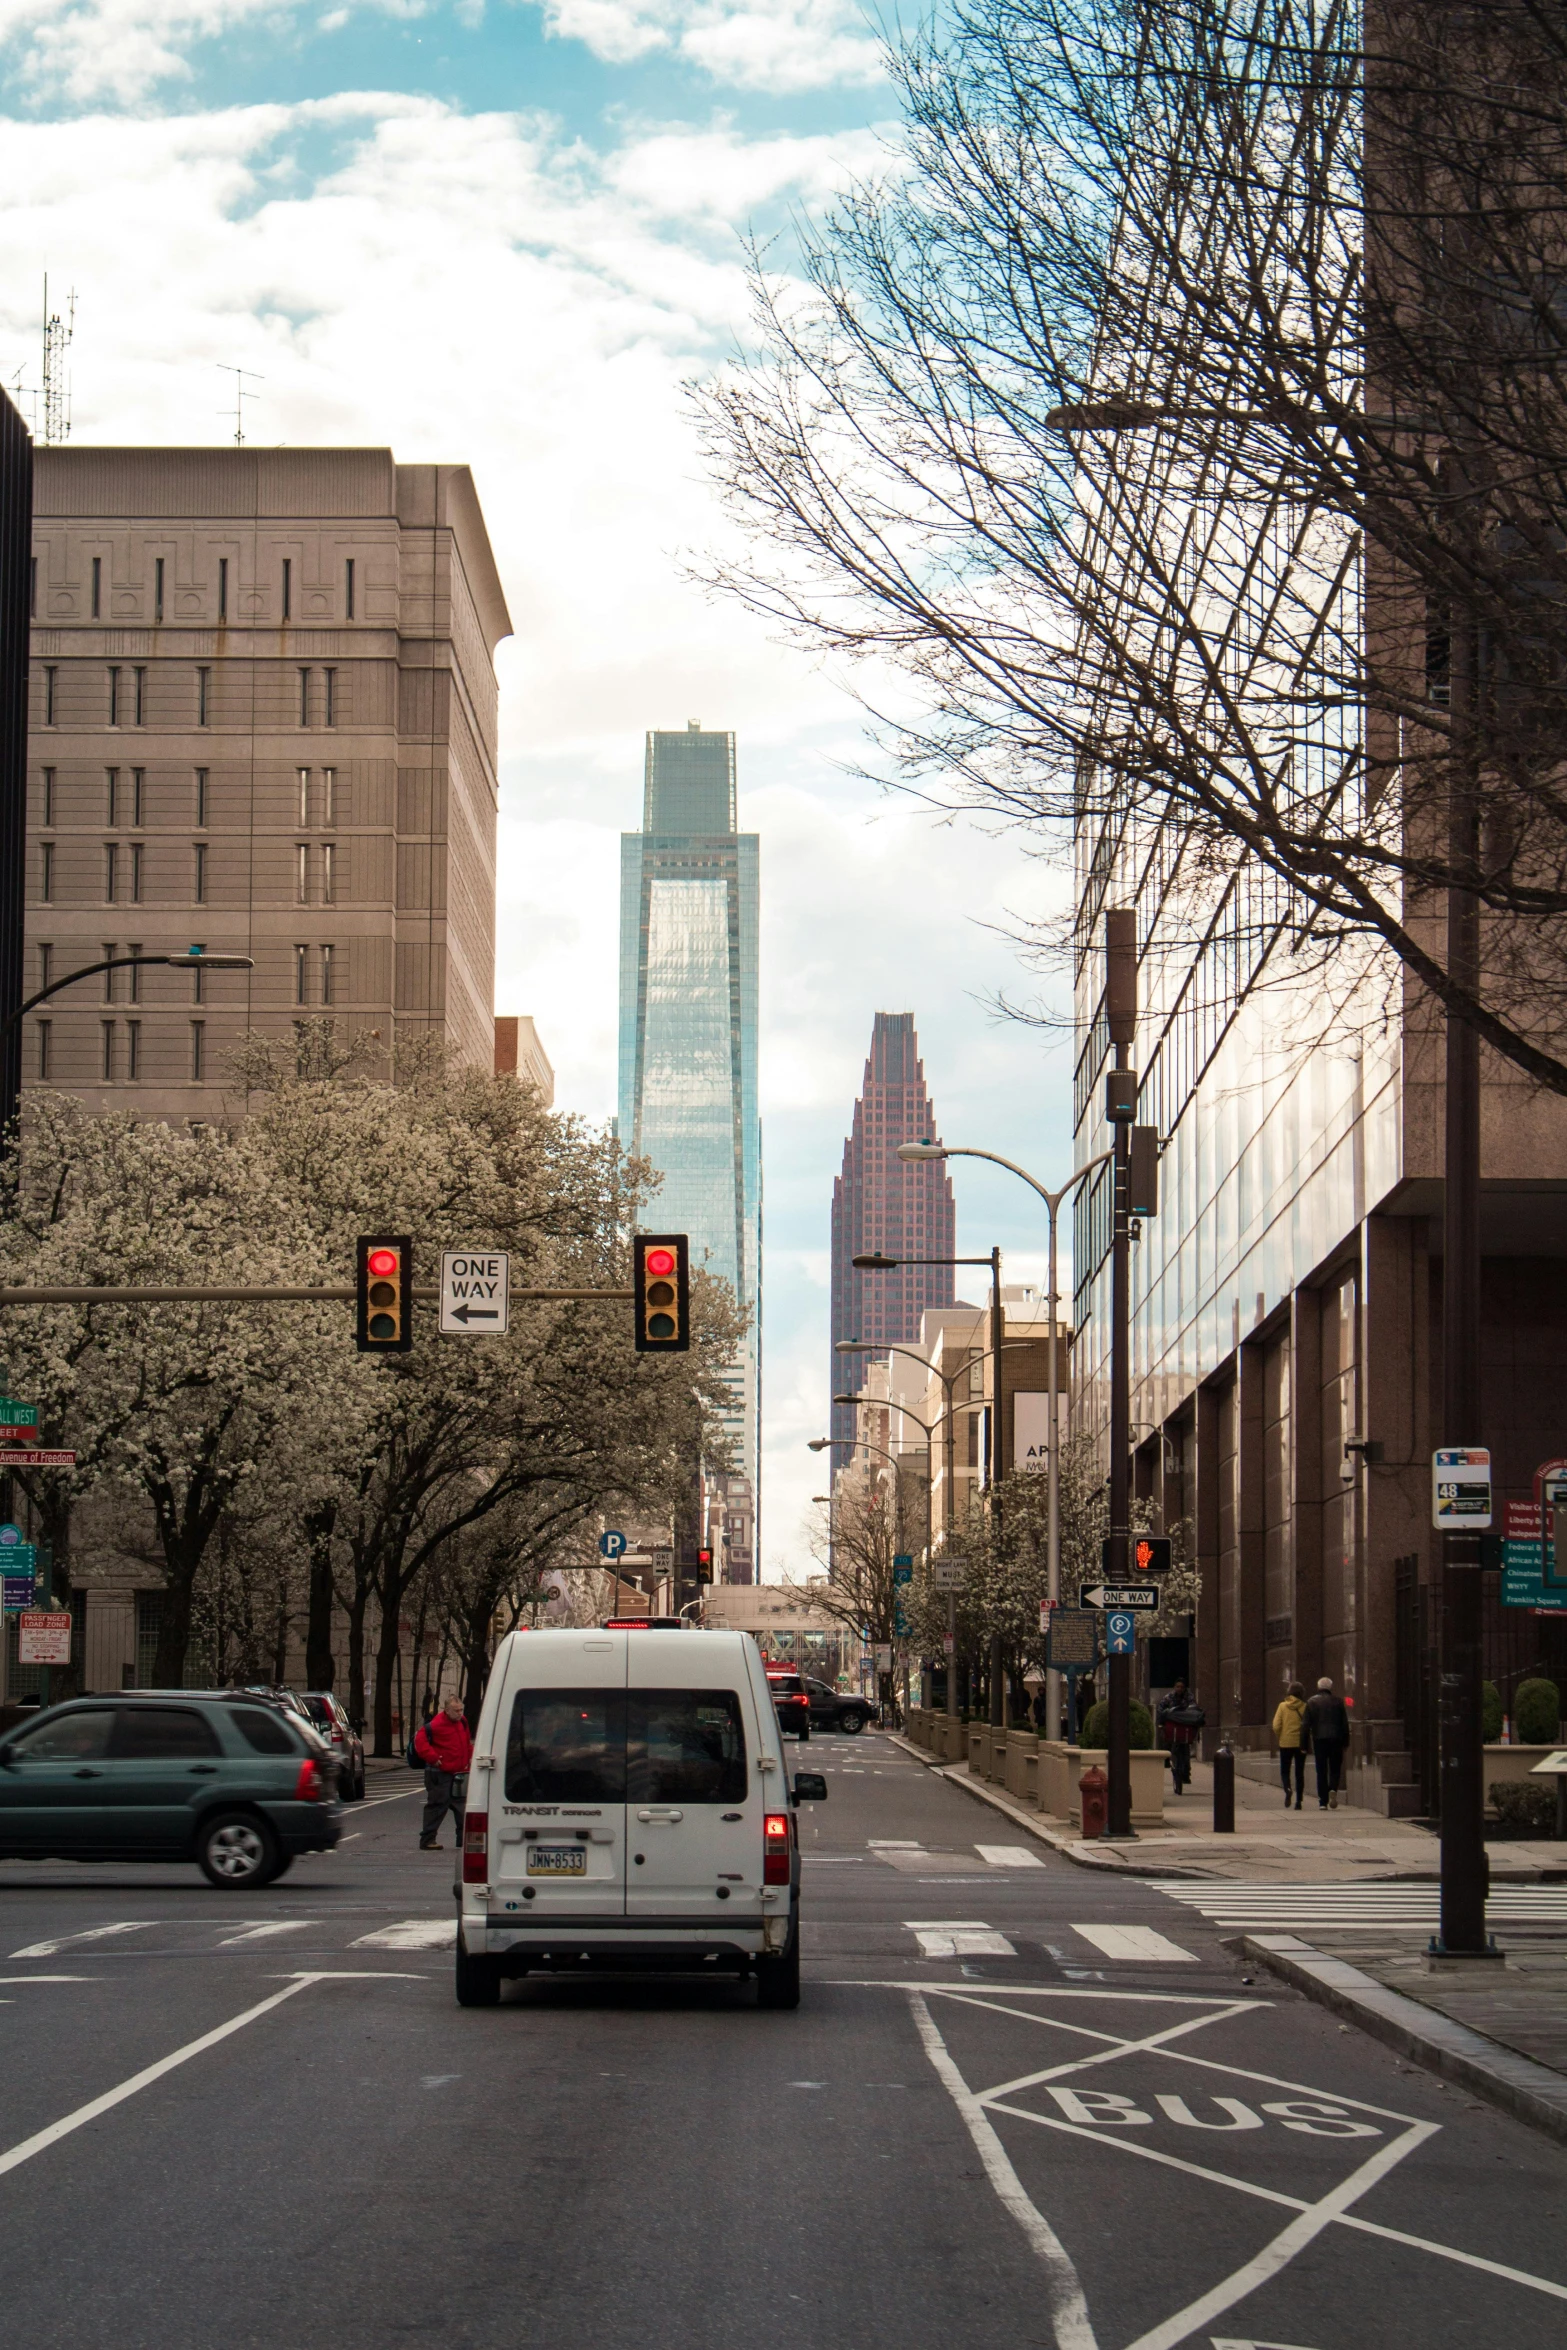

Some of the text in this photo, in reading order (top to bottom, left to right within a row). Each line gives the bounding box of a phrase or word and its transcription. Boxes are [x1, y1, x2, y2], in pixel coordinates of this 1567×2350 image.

[452, 1259, 498, 1276] ONE
[452, 1281, 498, 1298] WAY
[14, 1409, 34, 1424] WEST
[30, 1452, 38, 1462] of
[41, 1452, 73, 1463] Freedom
[1439, 1484, 1457, 1498] 48
[1509, 1516, 1534, 1526] Liberty
[608, 1535, 620, 1554] P
[1508, 1543, 1534, 1551] Federal
[1103, 1591, 1150, 1603] ONE WAY
[1507, 1595, 1562, 1606] Franklin Square
[502, 1806, 560, 1815] TRANSIT
[1044, 2087, 1383, 2137] BUS
